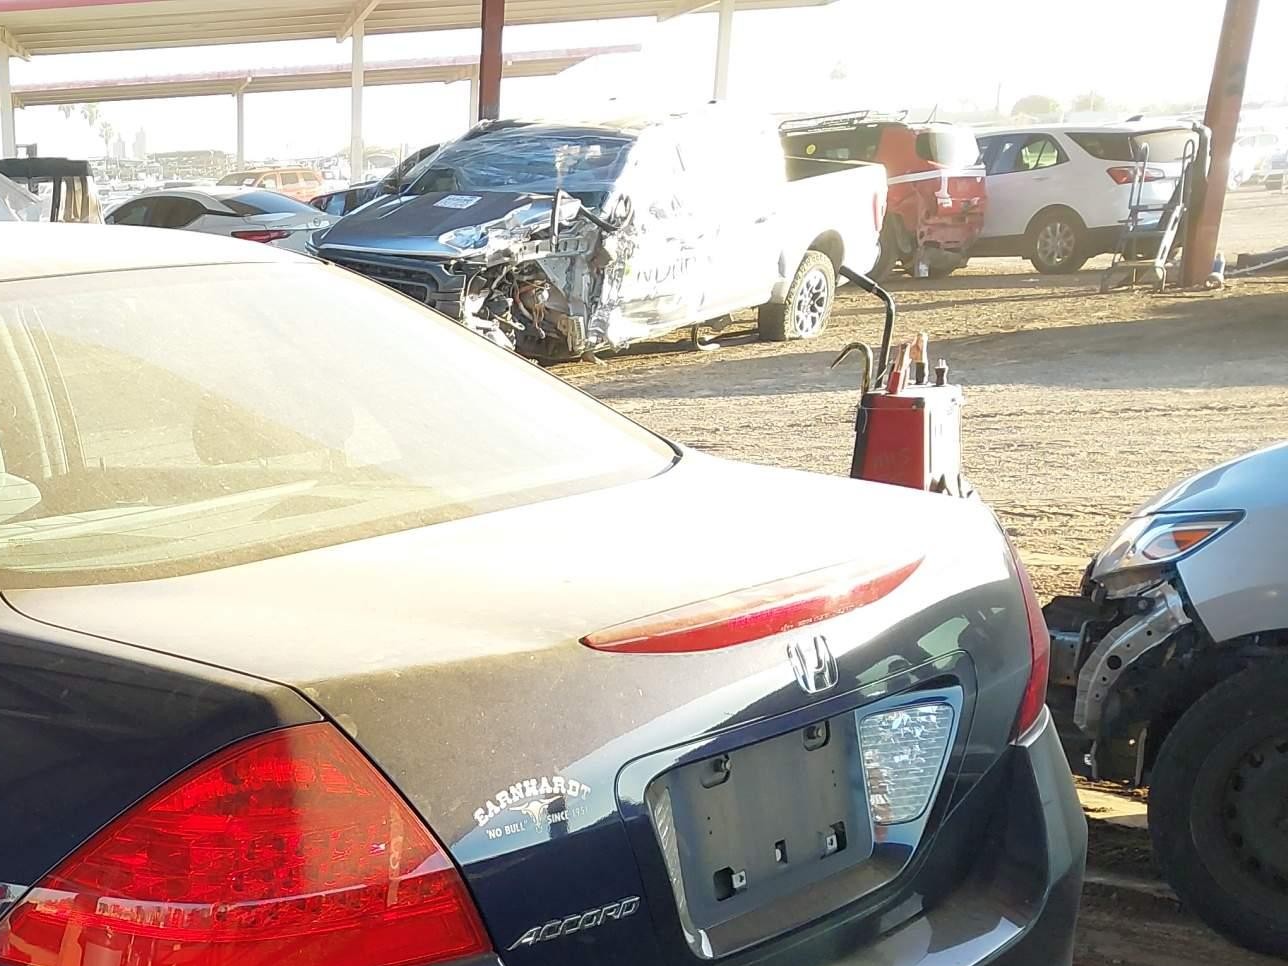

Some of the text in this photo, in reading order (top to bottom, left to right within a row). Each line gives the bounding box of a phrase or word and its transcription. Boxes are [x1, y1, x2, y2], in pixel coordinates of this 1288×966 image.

[473, 776, 592, 827] EARNHARDT
[546, 809, 569, 825] SINCE
[506, 896, 641, 951] ACCORD
